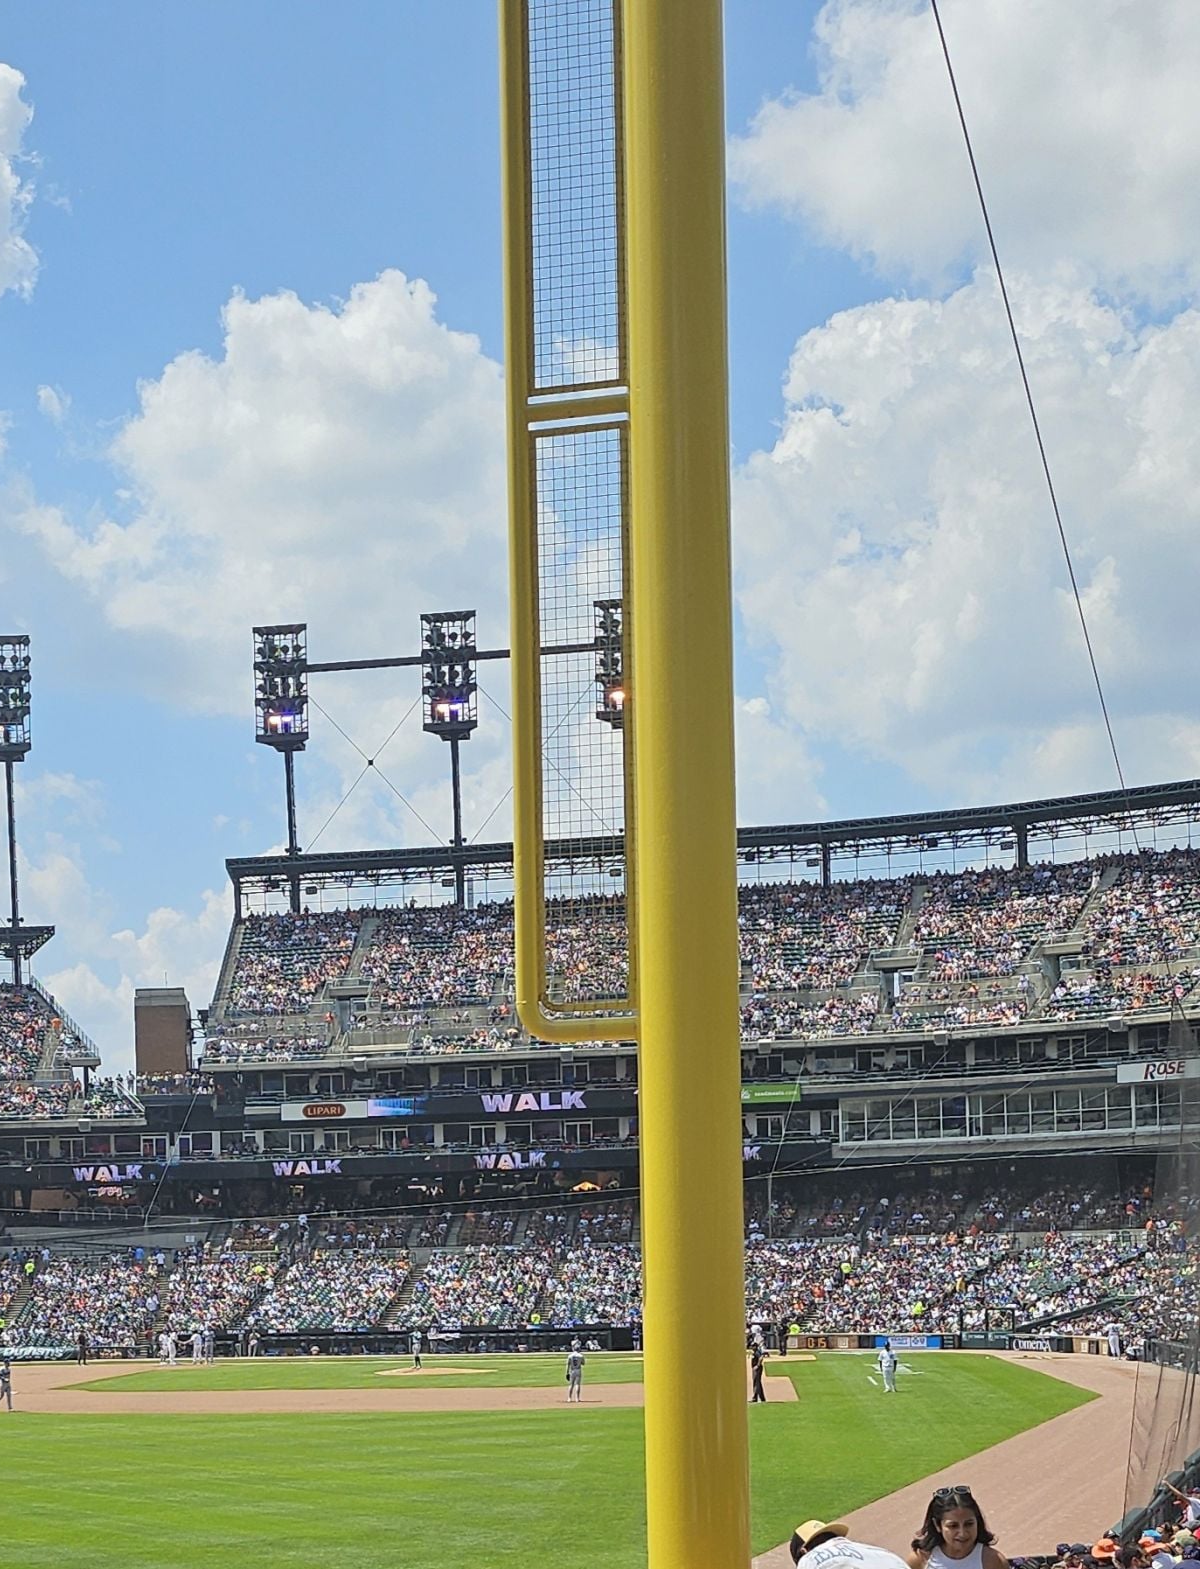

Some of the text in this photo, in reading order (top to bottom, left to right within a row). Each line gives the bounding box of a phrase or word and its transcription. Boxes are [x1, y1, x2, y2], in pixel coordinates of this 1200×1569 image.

[1144, 1061, 1186, 1080] ROSE
[481, 1090, 587, 1113] WALK
[307, 1106, 342, 1116] LIPARI
[272, 1160, 342, 1177] WALK
[474, 1149, 547, 1170] WALK
[72, 1164, 143, 1182] WALK
